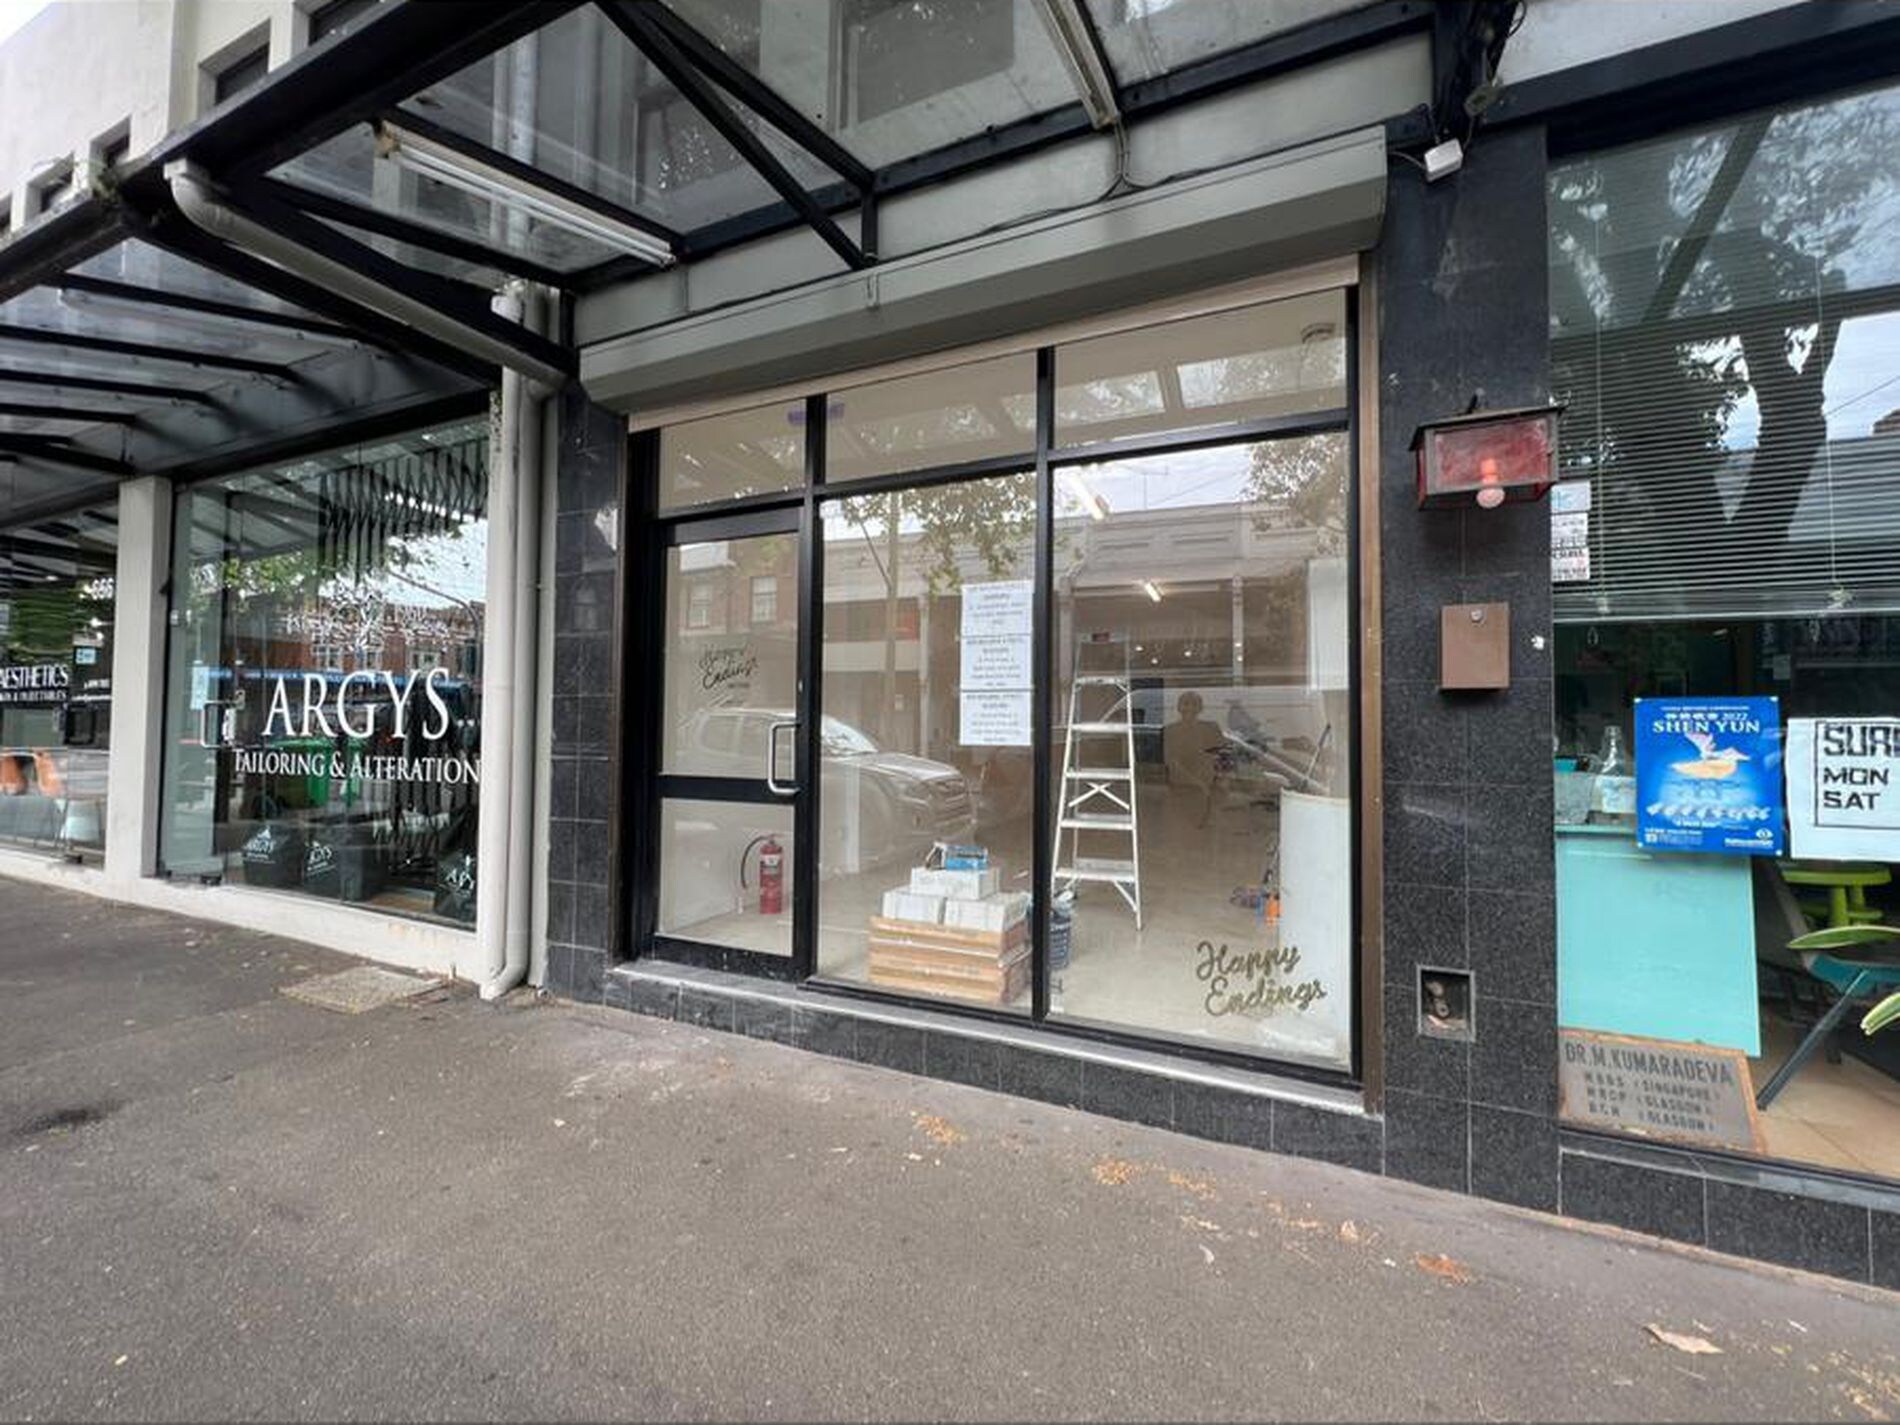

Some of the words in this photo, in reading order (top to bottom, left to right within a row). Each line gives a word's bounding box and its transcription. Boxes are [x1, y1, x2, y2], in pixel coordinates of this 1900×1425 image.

[261, 667, 450, 740] ARGYS
[1652, 719, 1709, 733] SHEN
[1715, 719, 1760, 733] YUN
[235, 749, 325, 777] TAILORING
[329, 751, 345, 778] &
[350, 750, 481, 785] ALTERATION
[1823, 767, 1889, 786] MON
[1823, 791, 1880, 810] SAT
[1196, 940, 1302, 981] Happy
[1205, 976, 1328, 1017] Endings
